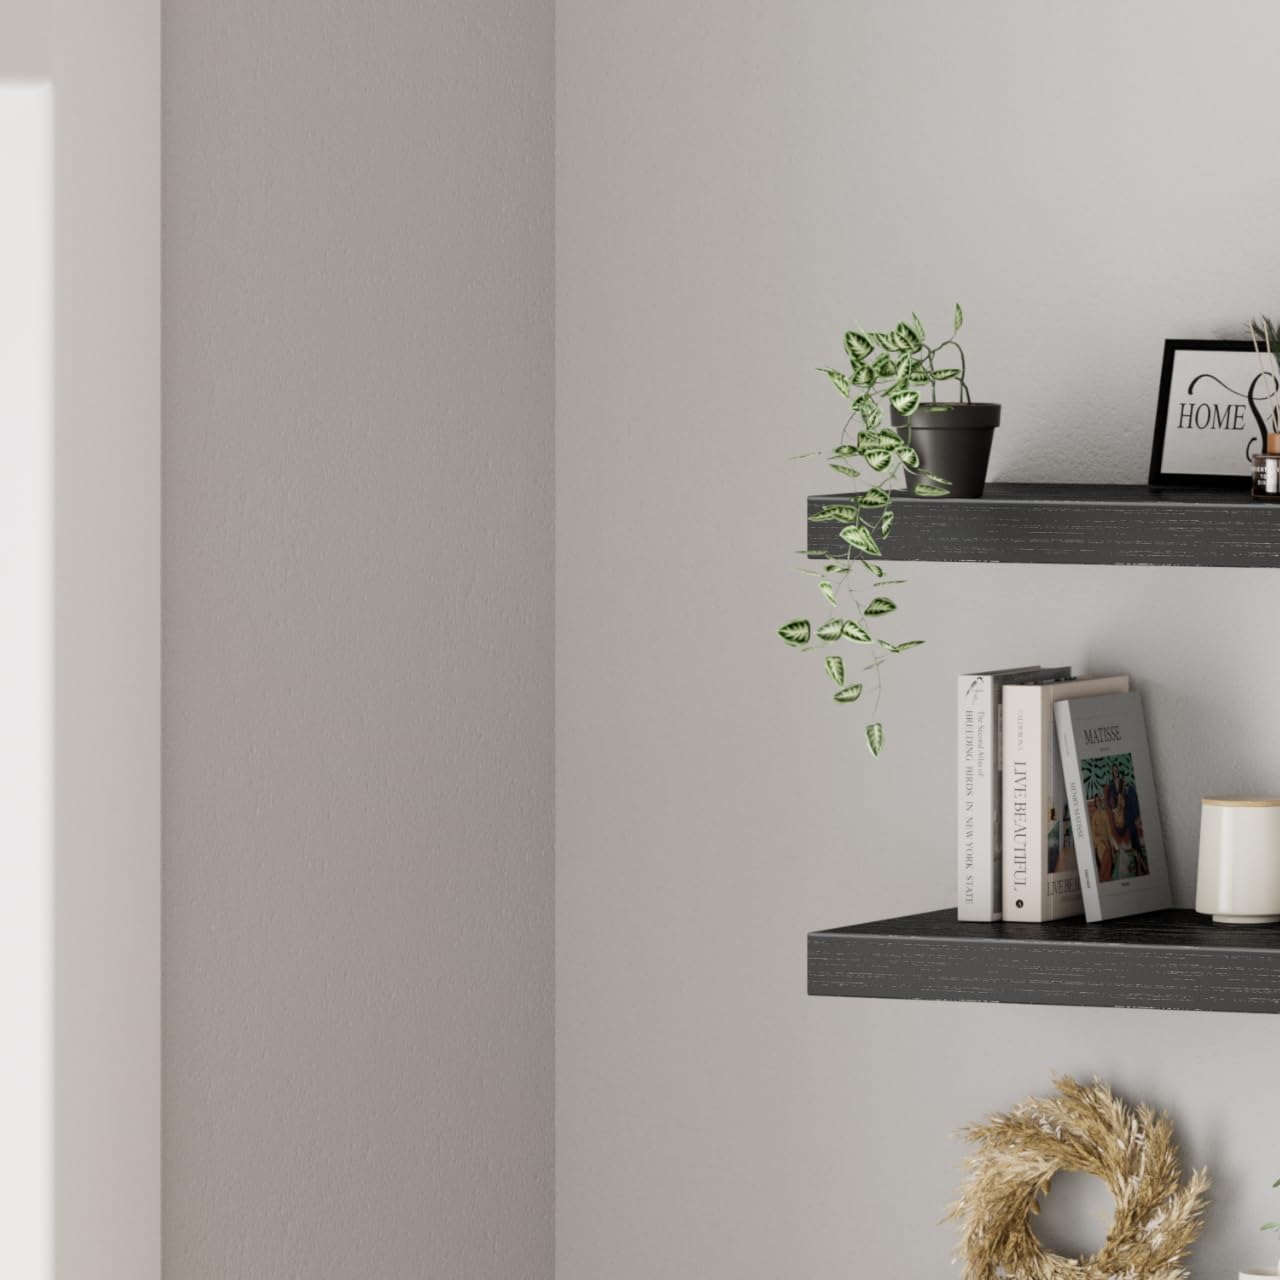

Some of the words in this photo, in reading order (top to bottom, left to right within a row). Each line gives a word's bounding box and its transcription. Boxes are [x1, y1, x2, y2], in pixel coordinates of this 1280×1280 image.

[1177, 402, 1247, 430] HOME
[964, 710, 974, 761] BREEDING
[1083, 725, 1122, 746] MATISSE
[964, 766, 974, 796] BIRDS
[1014, 761, 1027, 799] LIVE
[964, 801, 974, 811] IN
[964, 816, 974, 842] NEW
[964, 842, 974, 869] YORK
[1014, 802, 1027, 891] BEAUTIFUL
[964, 875, 974, 905] STATE
